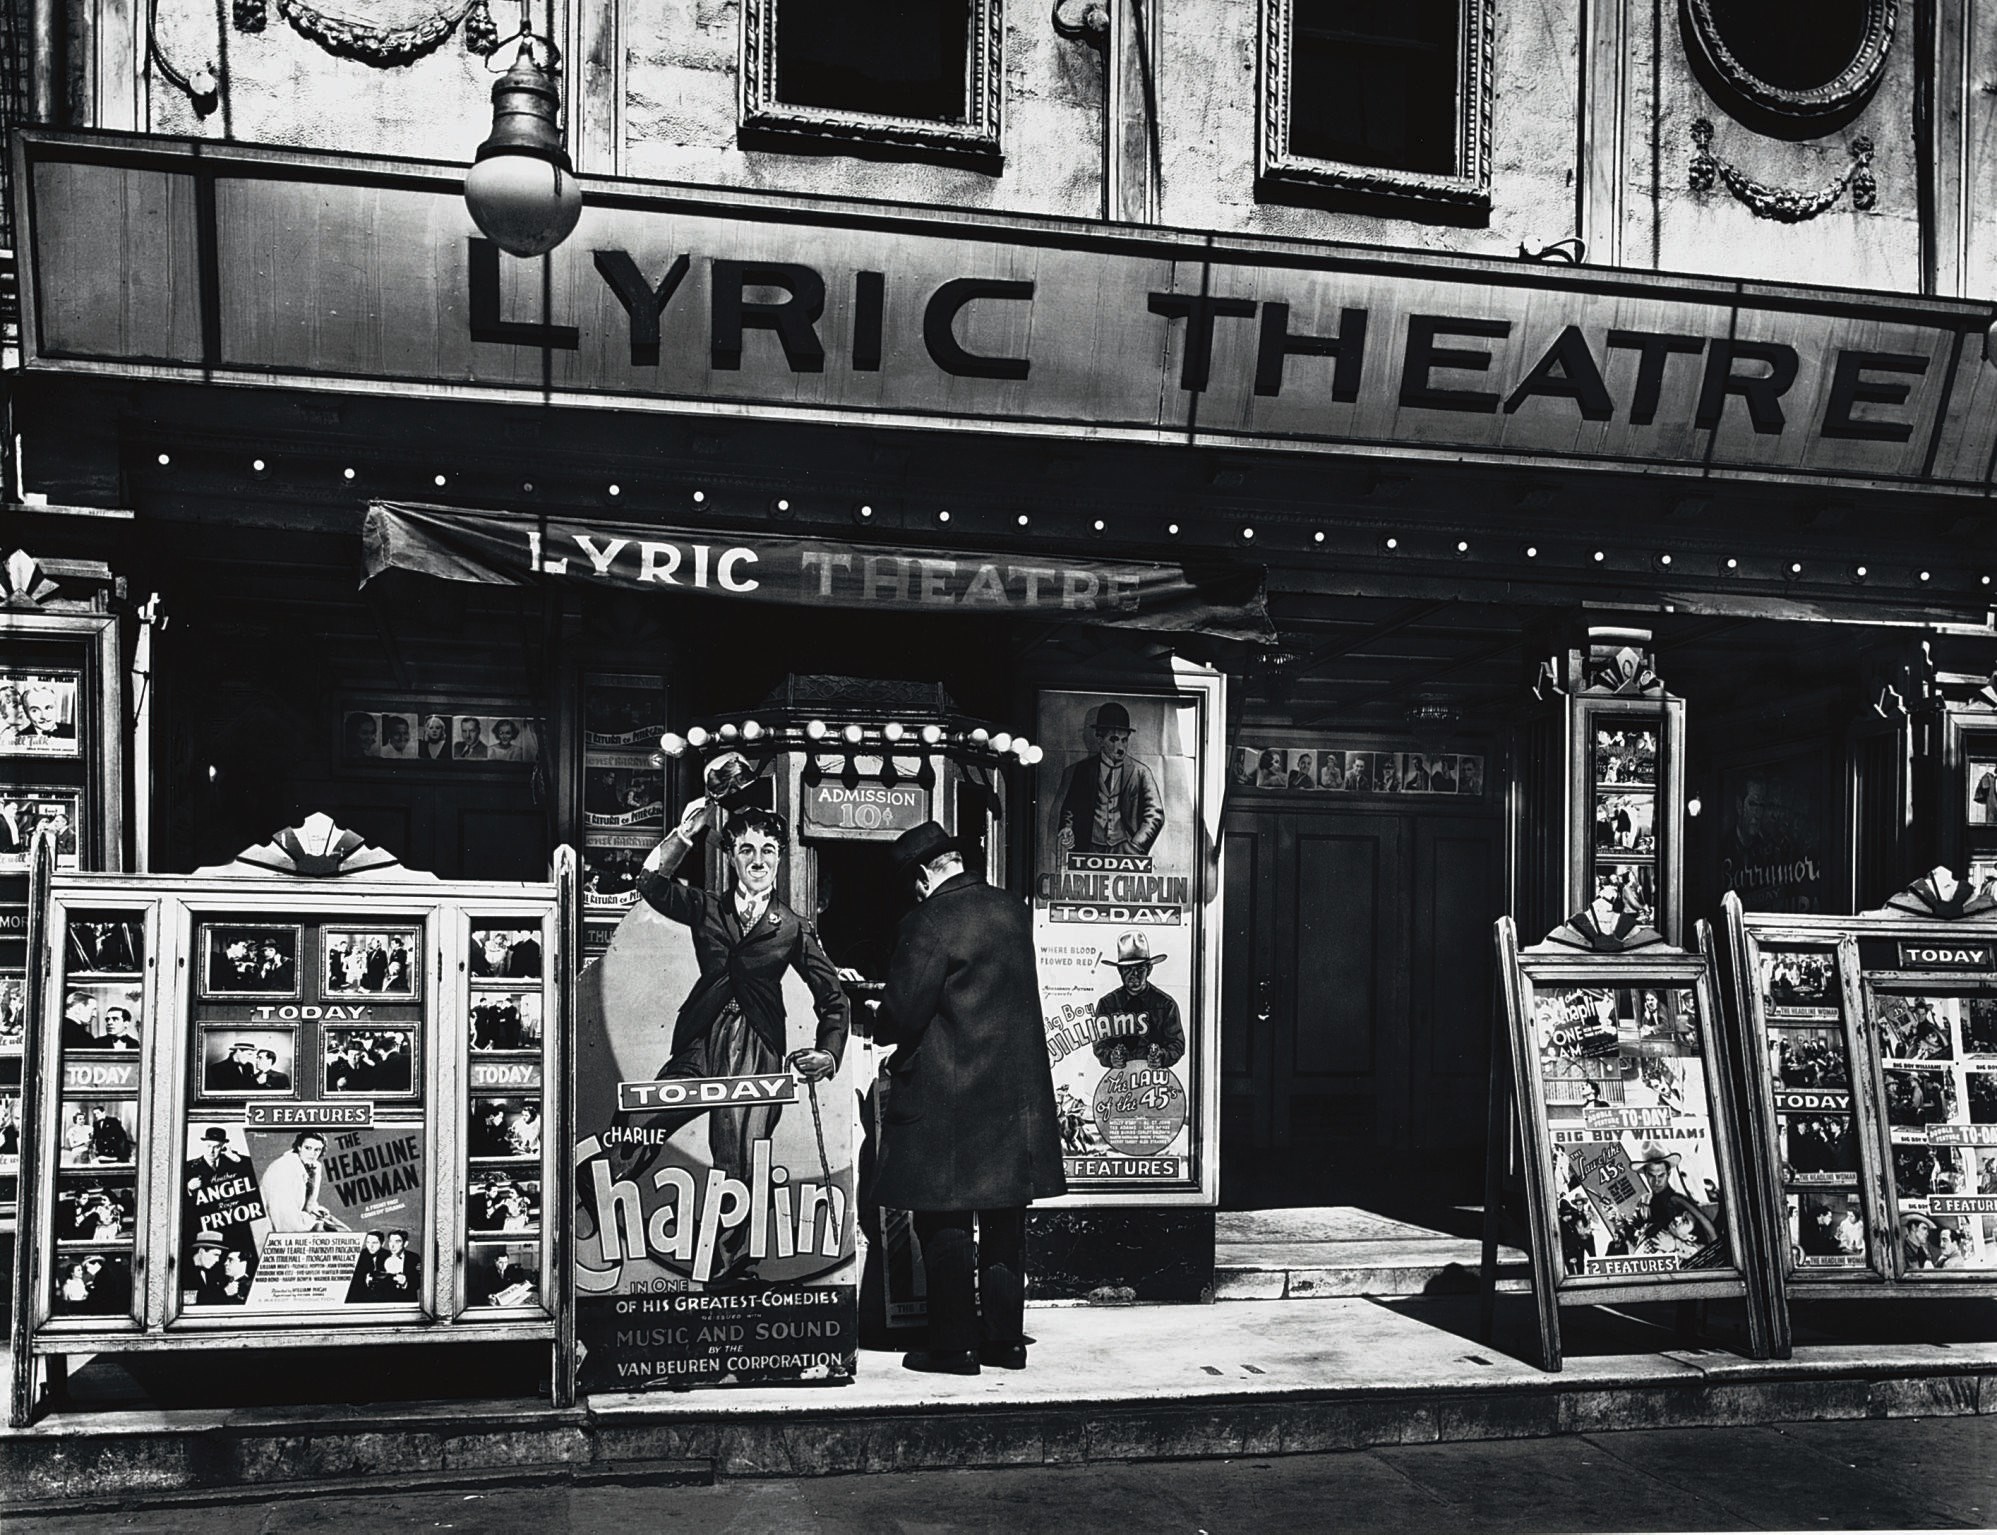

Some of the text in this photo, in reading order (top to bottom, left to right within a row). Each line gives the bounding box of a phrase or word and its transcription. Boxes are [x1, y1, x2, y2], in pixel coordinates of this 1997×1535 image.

[468, 236, 1930, 443] LYRIC THEATRE
[529, 531, 1142, 612] LYRIC THEATRE
[818, 788, 916, 807] ADMISSION
[1071, 856, 1149, 871] TODAY
[1036, 873, 1188, 903] CHARLIE CHAPLIN
[1056, 906, 1175, 922] TO-DAY
[1071, 947, 1096, 955] BLOOD
[1906, 949, 1984, 963] TODAY
[1040, 957, 1073, 966] FLOWED
[254, 1006, 370, 1021] TODAY
[1061, 1003, 1097, 1022] Boy
[1553, 1026, 1583, 1045] ONE
[67, 1066, 131, 1085] TODAY
[475, 1065, 534, 1084] TODAY
[1130, 1070, 1169, 1091] LAW
[630, 1078, 787, 1105] TO-DAY
[1096, 1097, 1114, 1122] of
[1116, 1092, 1138, 1113] the
[1774, 1095, 1850, 1109] TODAY
[254, 1107, 367, 1124] 2 FEATURES
[334, 1131, 362, 1150] THE
[603, 1126, 667, 1148] CHARLIE
[1556, 1128, 1706, 1142] BIG BOY WILLIAMS
[323, 1135, 421, 1183] HEADLINE
[1075, 1160, 1174, 1175] FEATURES
[196, 1176, 256, 1206] ANGEL
[334, 1163, 420, 1208] WOMAN
[1933, 1200, 1942, 1211] 2
[200, 1202, 263, 1232] PRYOR
[1591, 1258, 1675, 1273] 2 FEATURES
[630, 1278, 689, 1293] IN ONE
[616, 1300, 636, 1314] OF
[642, 1300, 670, 1313] HIS
[617, 1320, 841, 1348] MUSIC AND SOUND
[708, 1345, 744, 1354] BY THE
[618, 1353, 843, 1377] VAN BEUREN CORPORATION
